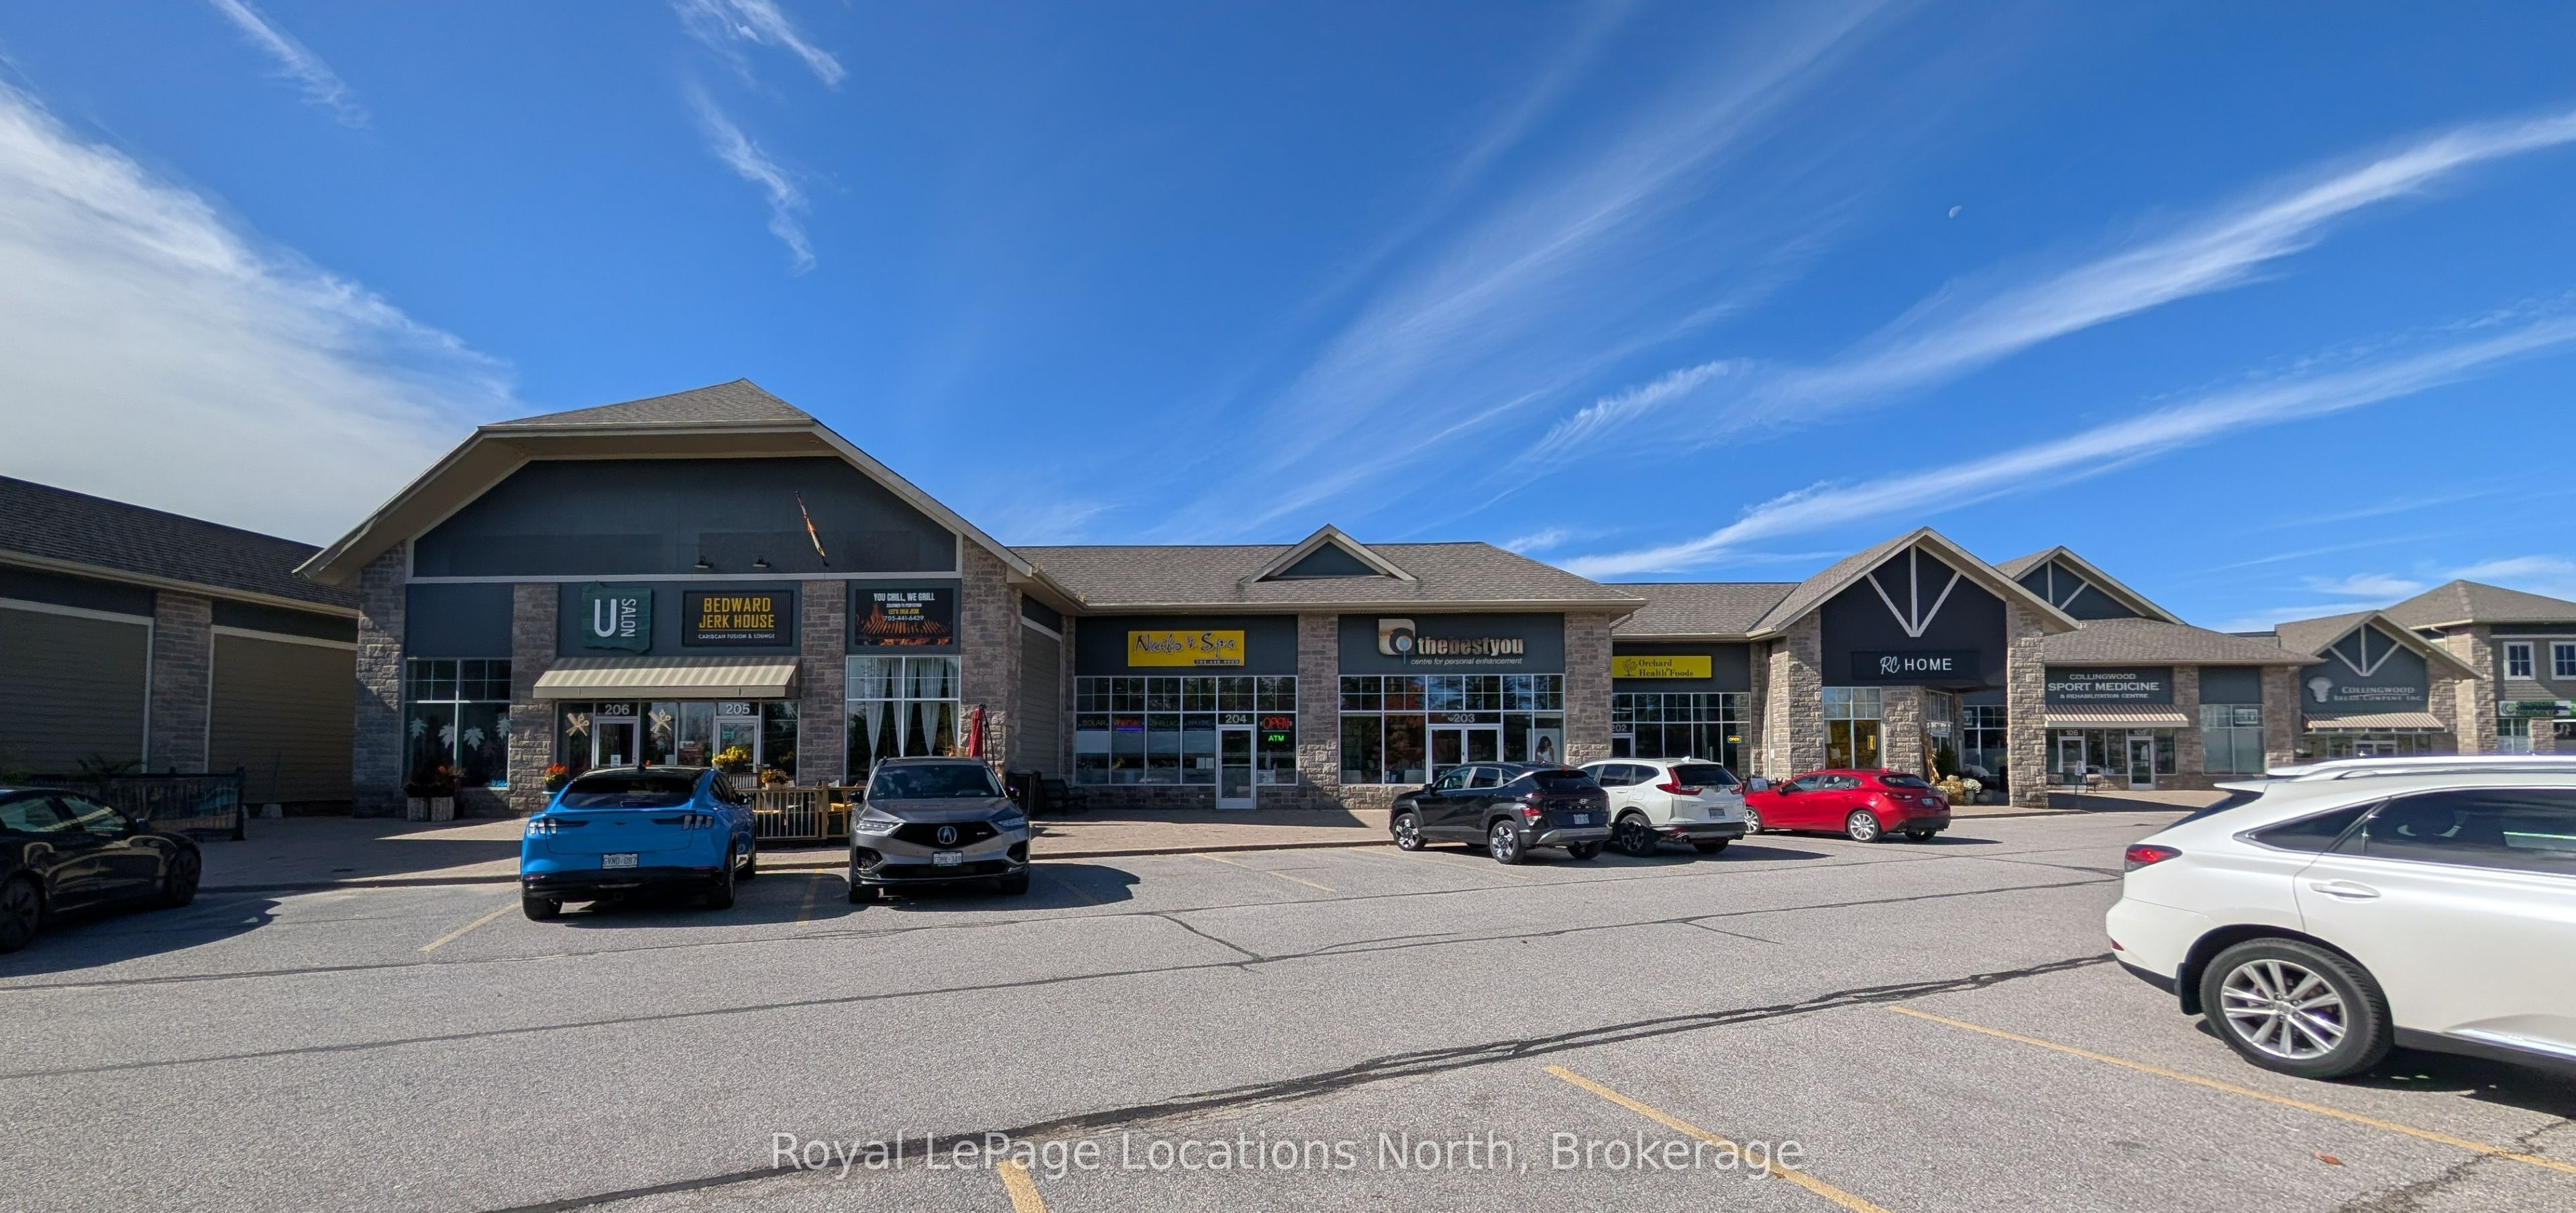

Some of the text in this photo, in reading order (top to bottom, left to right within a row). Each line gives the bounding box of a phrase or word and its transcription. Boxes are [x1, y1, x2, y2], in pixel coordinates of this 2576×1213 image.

[873, 592, 935, 602] YOU CHILL, WE GRILL
[704, 597, 771, 613] BEDWARD
[594, 598, 617, 637] U
[621, 598, 637, 637] SALON
[699, 615, 775, 629] JERK HOUSE
[1200, 633, 1236, 659] Spa
[1417, 637, 1524, 656] thebestyou
[1444, 657, 1474, 666] personal
[1638, 659, 1672, 667] Orchard
[1880, 656, 1952, 675] RC HOME
[1639, 669, 1695, 677] Health Foods
[2047, 682, 2159, 691] SPORT MEDICINE
[604, 704, 630, 715] 206
[725, 704, 750, 715] 205
[1225, 714, 1248, 724] 204
[1263, 717, 1291, 730] OPEN
[1453, 713, 1475, 723] 203
[1611, 724, 1627, 732] 202
